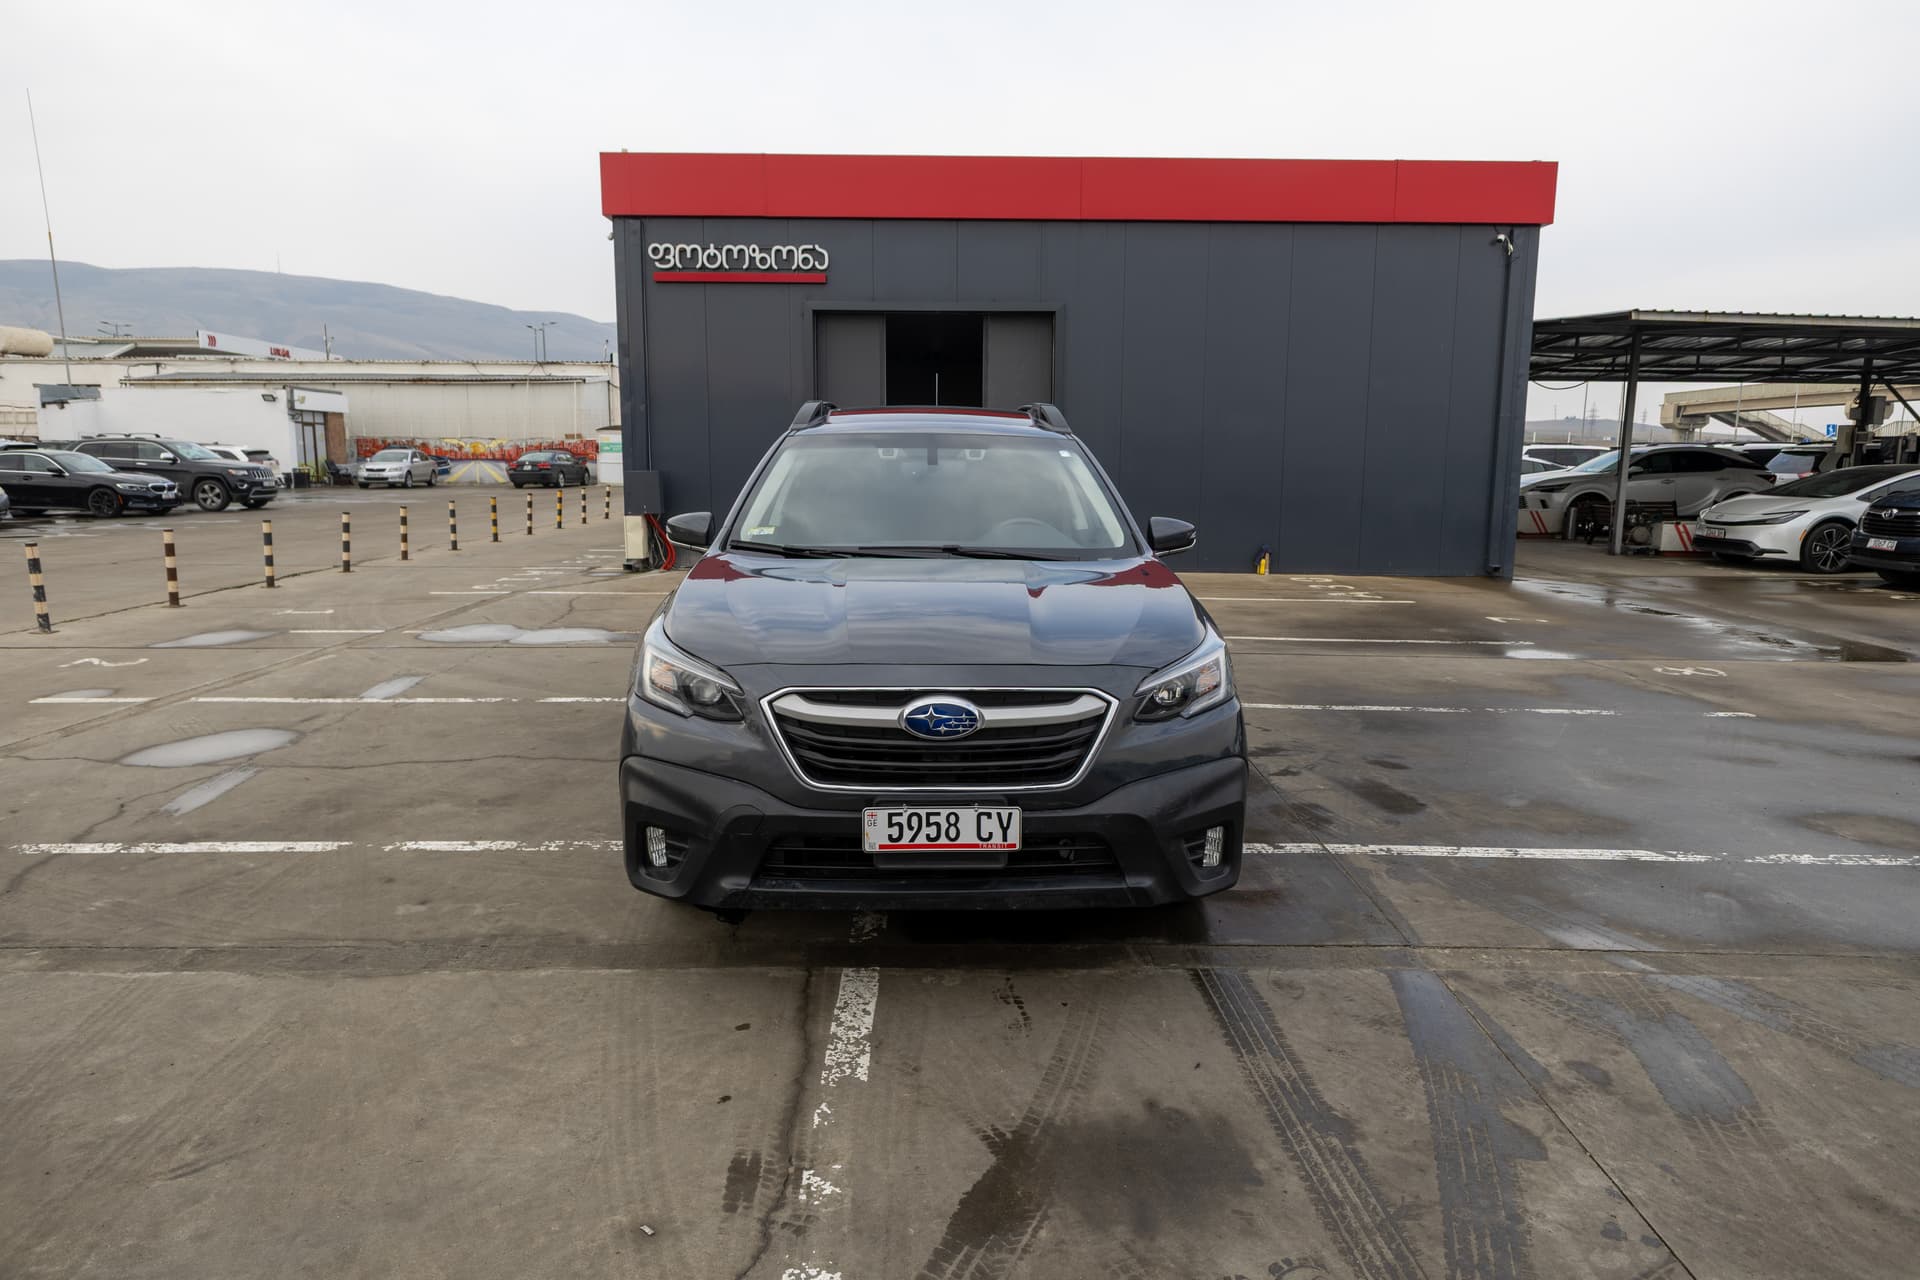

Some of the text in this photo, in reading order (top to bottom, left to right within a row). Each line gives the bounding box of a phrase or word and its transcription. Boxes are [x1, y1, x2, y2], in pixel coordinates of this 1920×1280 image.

[648, 243, 830, 271] ფოტოზონა
[866, 819, 878, 827] GE
[887, 811, 1013, 843] 5958 CY
